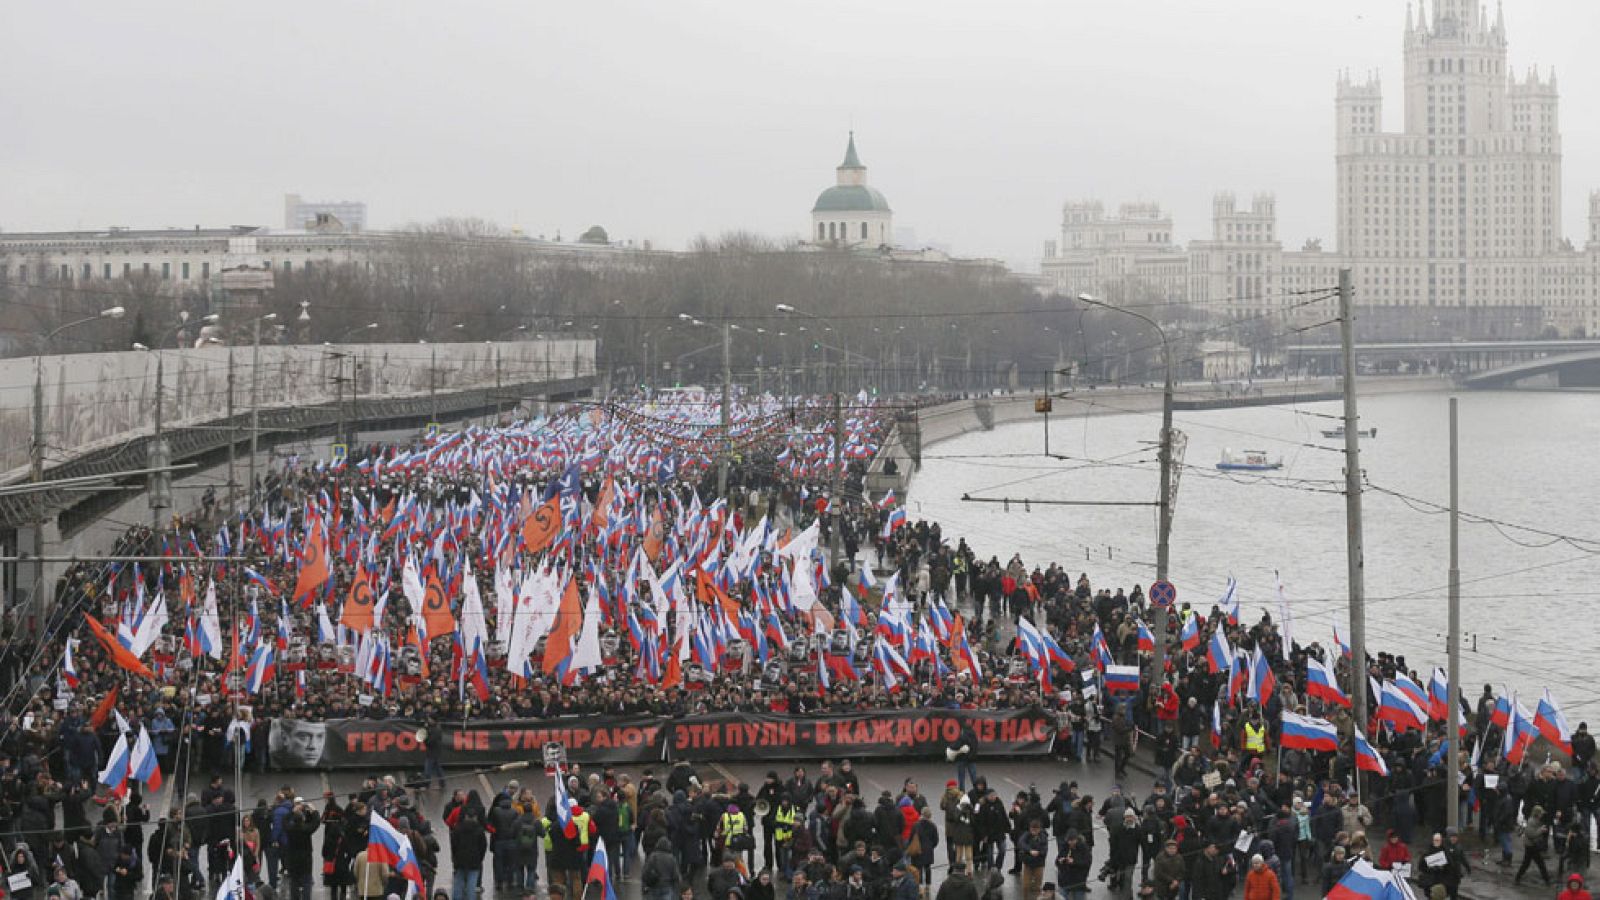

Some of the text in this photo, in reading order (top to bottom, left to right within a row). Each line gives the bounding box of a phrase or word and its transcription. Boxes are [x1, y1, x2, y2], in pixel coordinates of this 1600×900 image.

[347, 726, 660, 752] ГЕРО НЕ УМИРАЮТ
[676, 723, 721, 749] ЭТИ
[726, 720, 797, 747] ПУЛИ
[815, 719, 832, 745] В
[836, 718, 961, 746] КАЖДОГО
[1000, 718, 1048, 743] НАС
